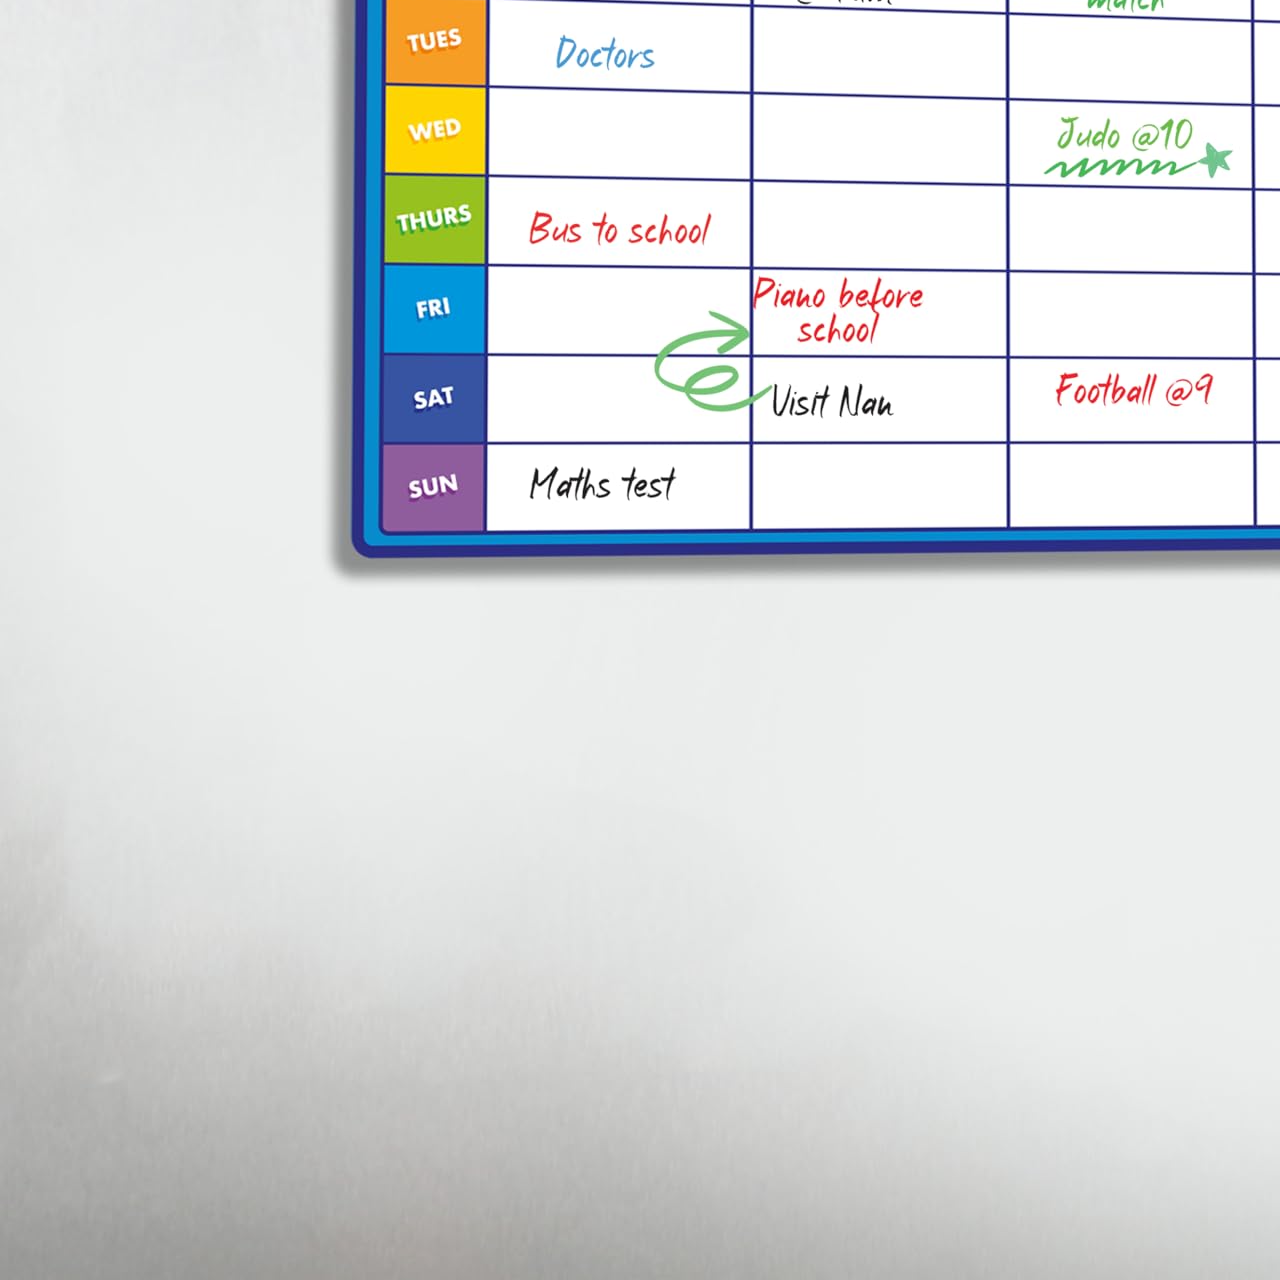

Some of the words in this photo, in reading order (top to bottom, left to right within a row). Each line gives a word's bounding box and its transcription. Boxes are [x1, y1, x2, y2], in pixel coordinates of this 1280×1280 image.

[406, 27, 463, 53] TUES
[555, 34, 656, 70] Doctors
[407, 117, 462, 143] WED
[1057, 116, 1121, 150] Judo
[1131, 118, 1193, 151] @10
[396, 203, 473, 235] THURS
[529, 210, 583, 245] Bus
[592, 212, 618, 246] to
[628, 212, 712, 246] school
[415, 296, 451, 320] FRI
[752, 276, 826, 310] Piano
[838, 277, 924, 313] before
[797, 312, 880, 344] school
[413, 385, 455, 411] SAT
[772, 383, 830, 418] Visit
[839, 384, 894, 418] Nan
[1055, 372, 1158, 407] Football
[1165, 373, 1214, 407] @9
[408, 473, 459, 501] SUN
[529, 466, 612, 500] Maths
[621, 466, 677, 501] test
